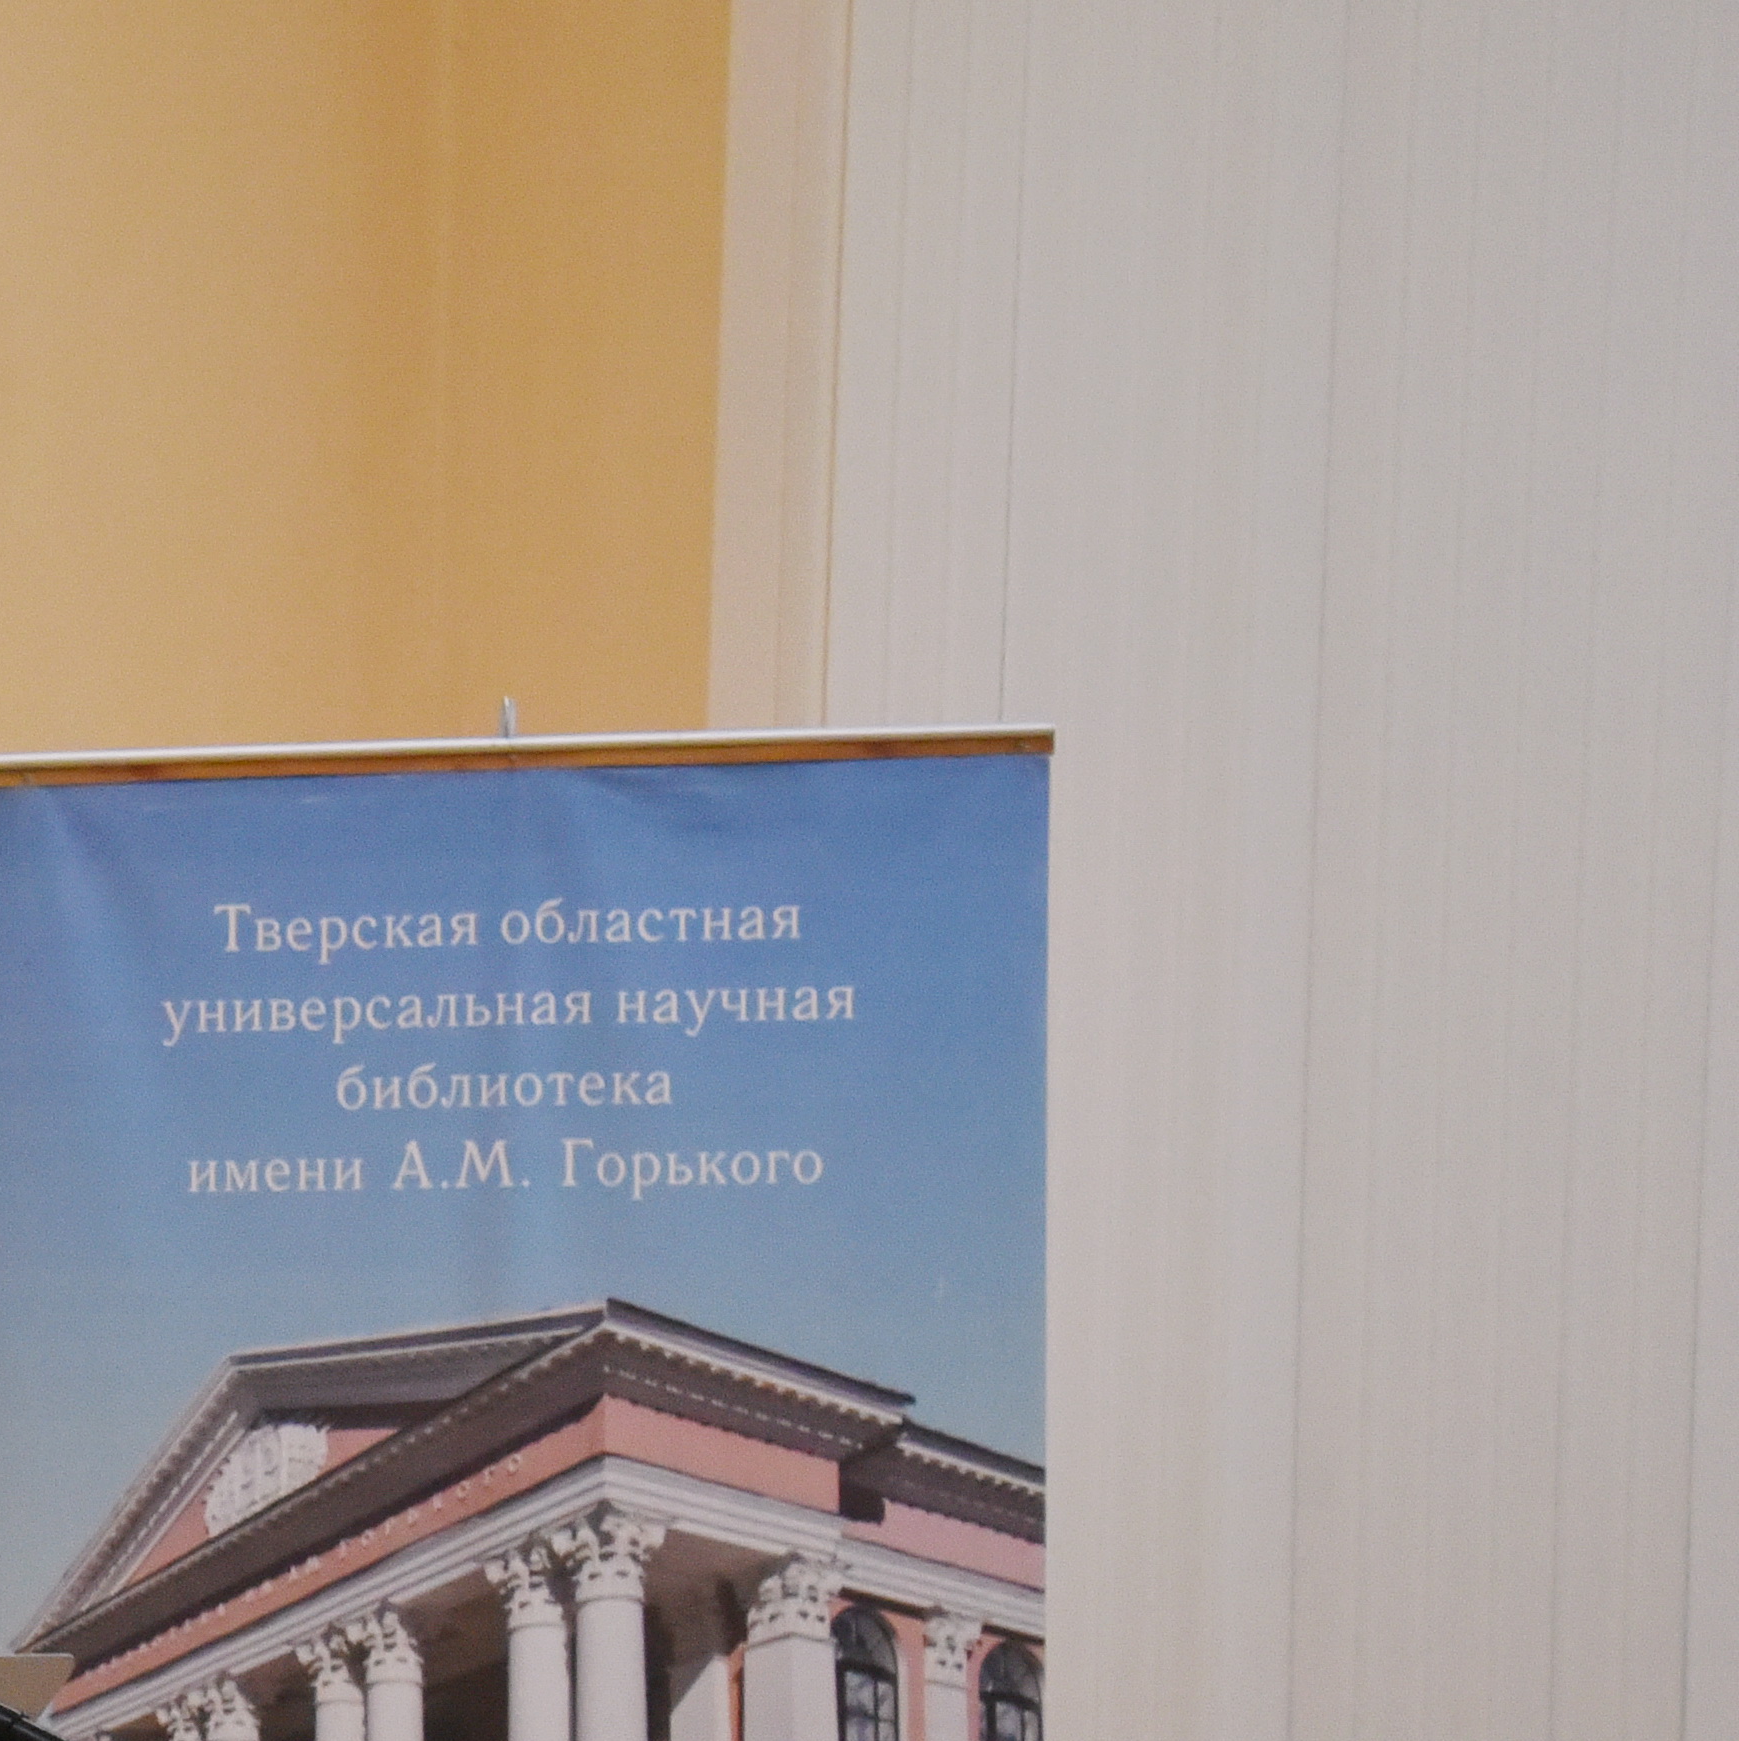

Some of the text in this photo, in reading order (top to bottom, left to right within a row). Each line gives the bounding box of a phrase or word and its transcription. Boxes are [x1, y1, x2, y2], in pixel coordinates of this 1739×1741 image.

[214, 898, 800, 965] Тверская областная
[163, 986, 854, 1047] универсальная научная
[336, 1063, 672, 1110] библиотека
[189, 1138, 824, 1200] имени А.М. Горького
